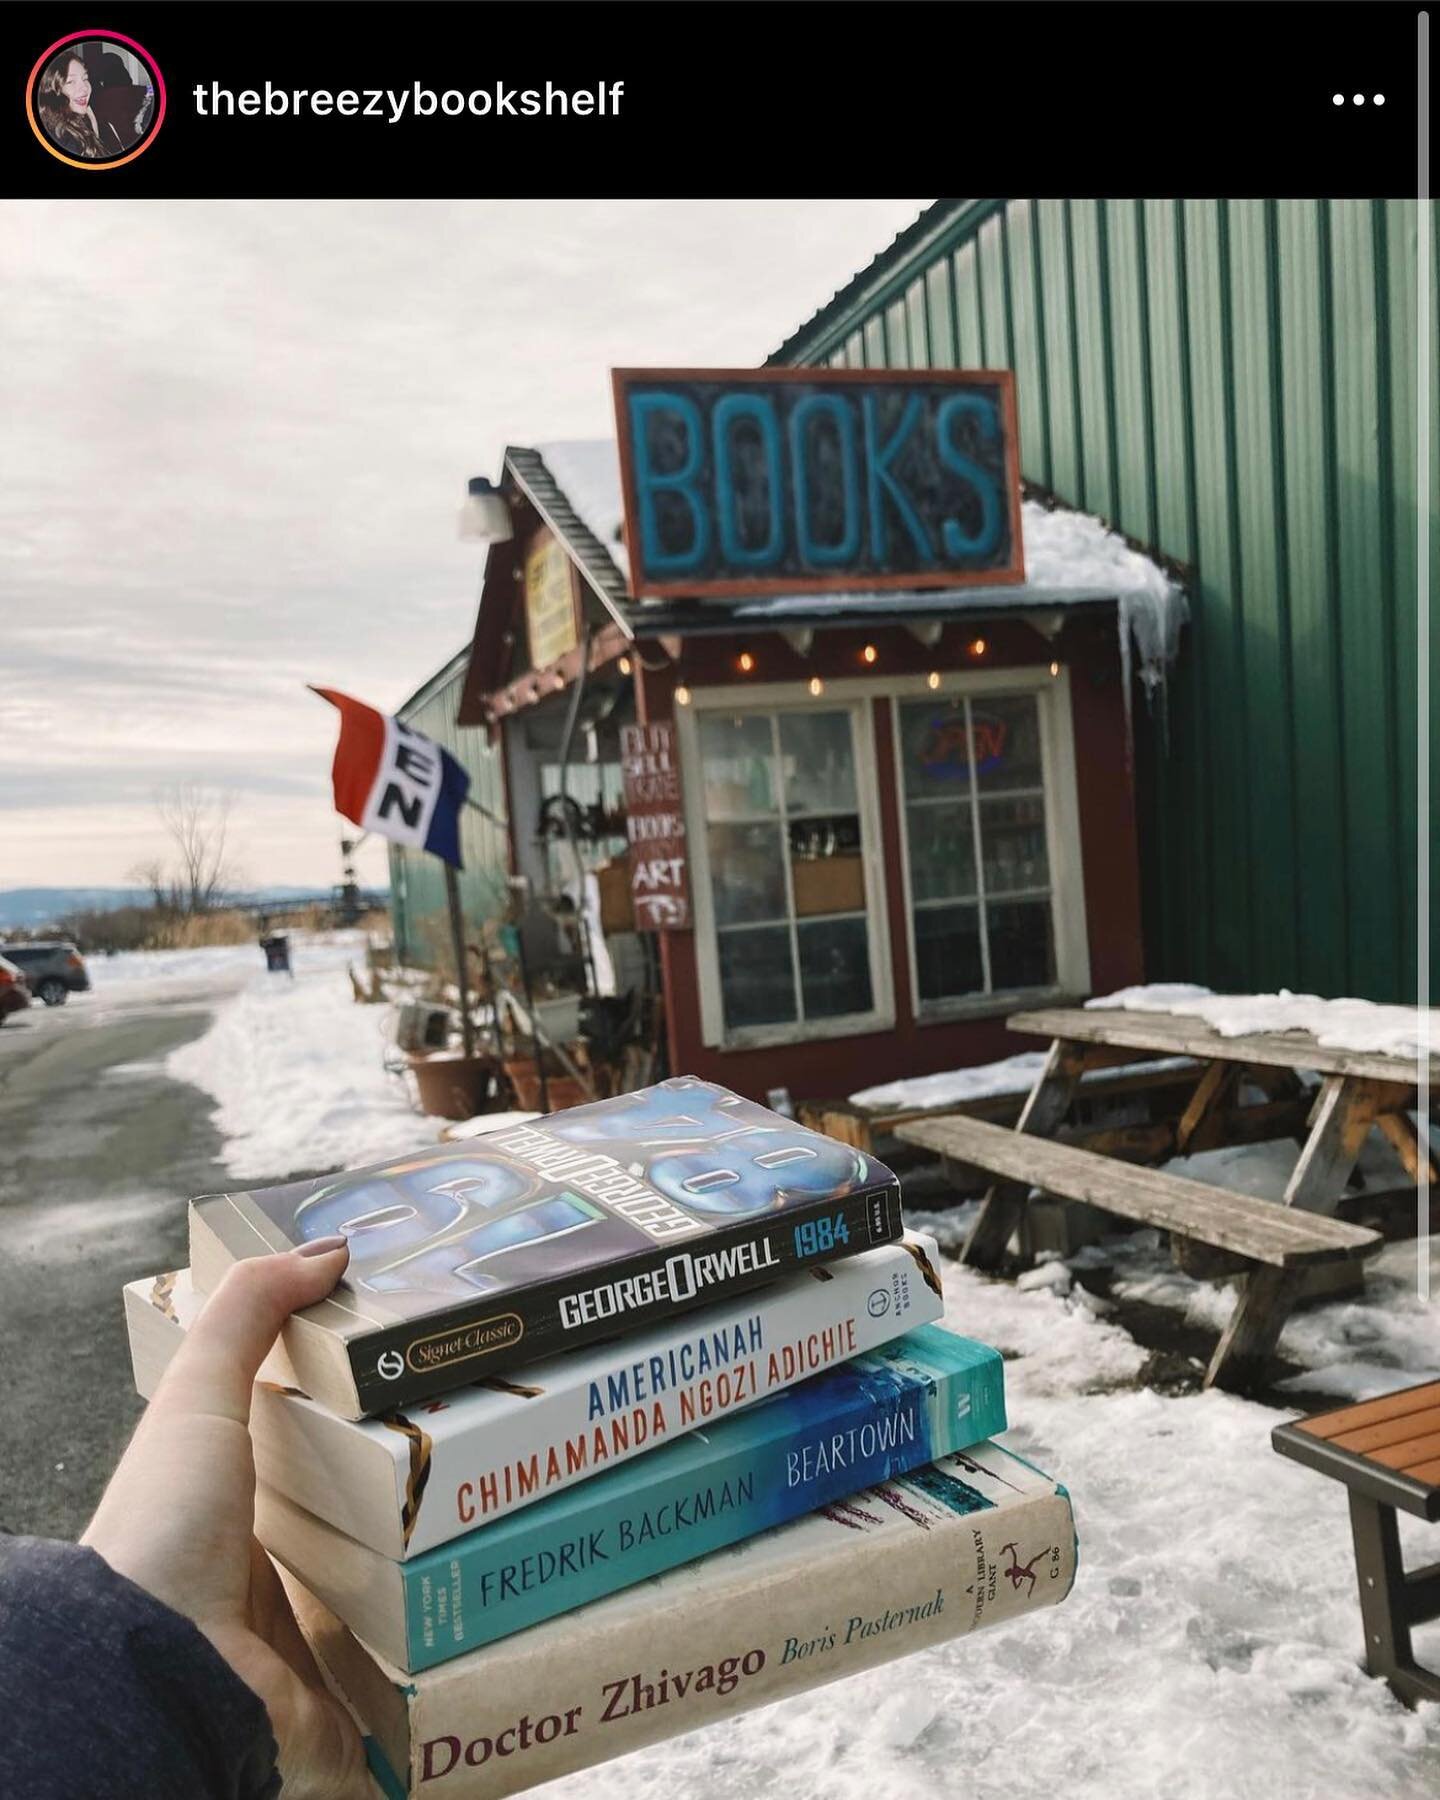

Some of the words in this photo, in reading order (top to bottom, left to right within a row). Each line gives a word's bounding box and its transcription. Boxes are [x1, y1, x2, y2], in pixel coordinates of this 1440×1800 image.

[628, 391, 1000, 572] BOOKS
[632, 857, 685, 890] ART
[793, 1213, 851, 1259] 1984
[418, 1334, 462, 1364] Signet
[465, 1320, 516, 1350] Classic
[587, 1315, 764, 1421] AMERICANAH
[456, 1408, 668, 1525] CHIMAMANDA
[679, 1361, 757, 1423] NGOZI
[767, 1318, 858, 1374] ADICHIE
[785, 1409, 917, 1489] BEARTOWN
[479, 1527, 608, 1607] FREDRIK
[618, 1471, 754, 1552] BACKMAN
[972, 1529, 985, 1581] LIBRARY
[1051, 1545, 1061, 1562] 86
[421, 1575, 432, 1613] YORK
[987, 1563, 997, 1601] GIANT
[778, 1628, 838, 1667] Boris
[842, 1589, 945, 1645] Pasternak
[420, 1700, 583, 1783] Doctor
[600, 1647, 767, 1723] Zhivago
